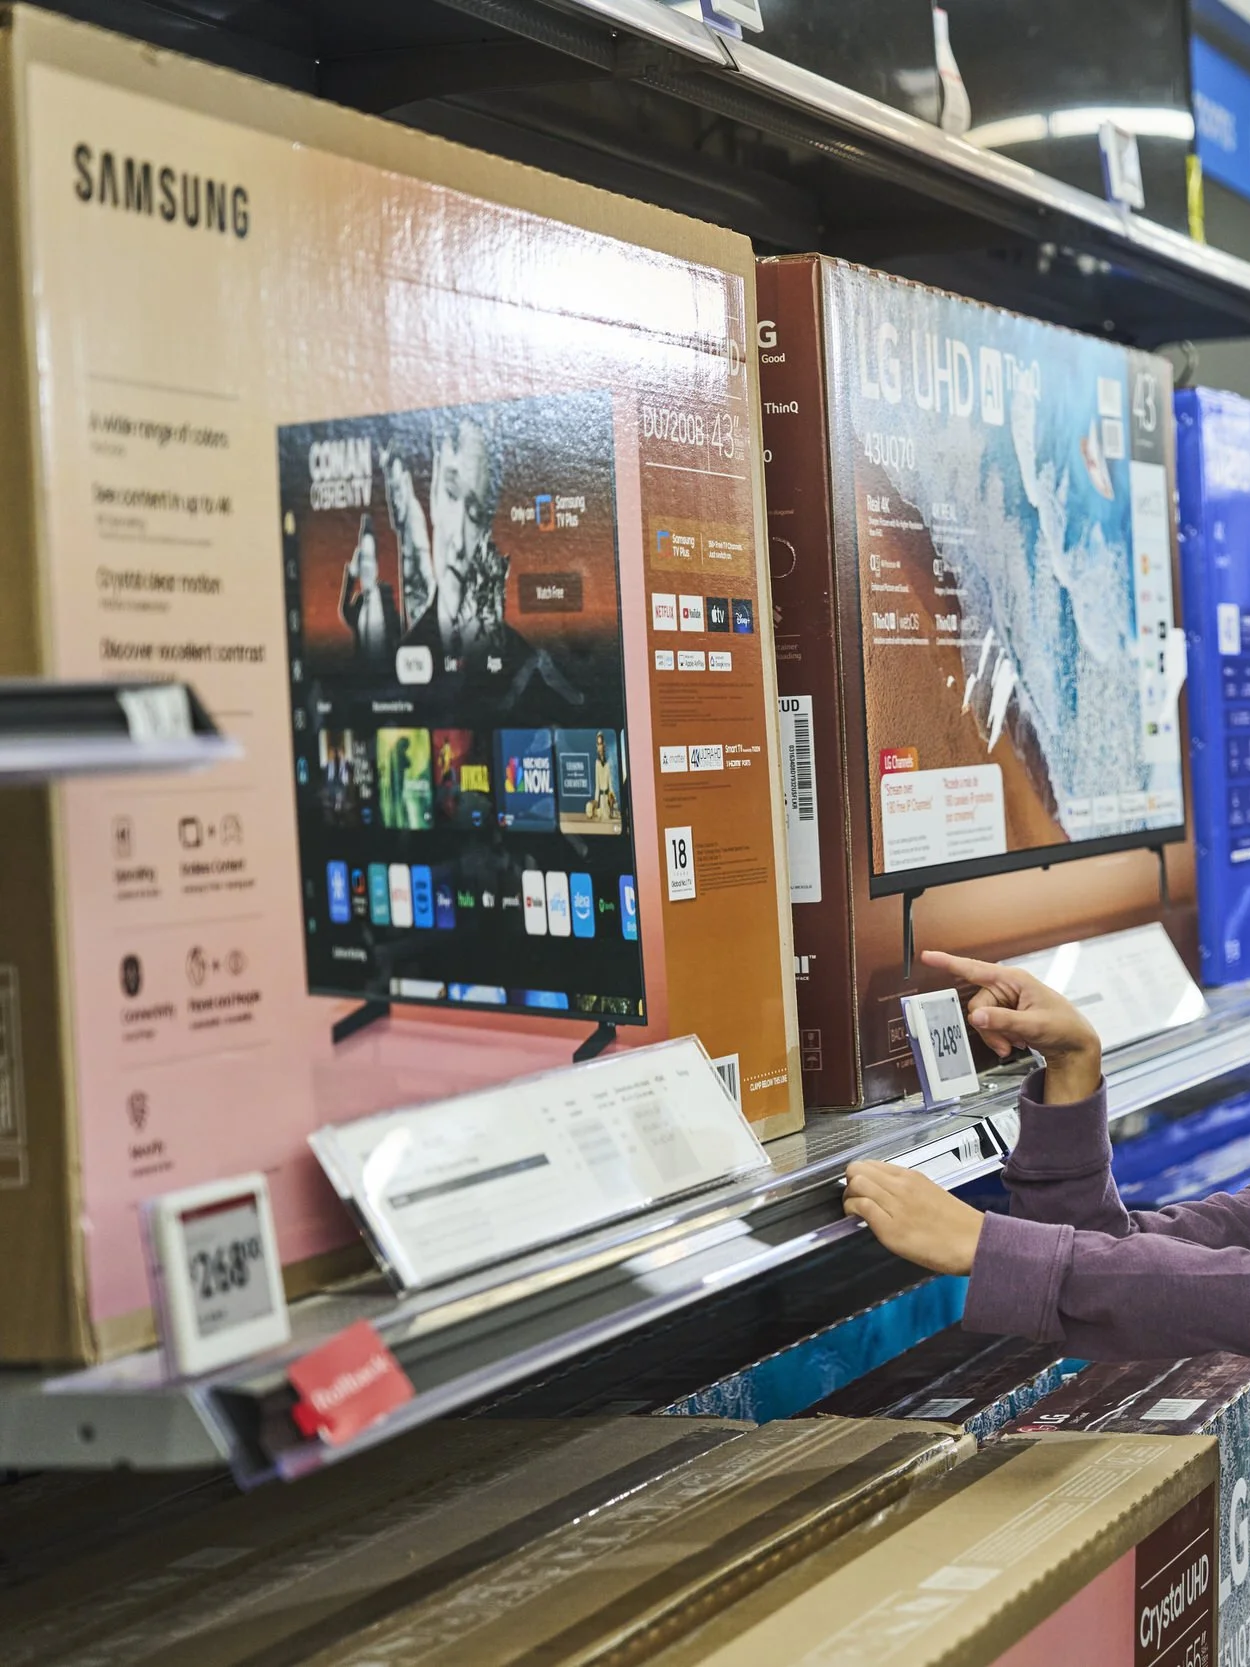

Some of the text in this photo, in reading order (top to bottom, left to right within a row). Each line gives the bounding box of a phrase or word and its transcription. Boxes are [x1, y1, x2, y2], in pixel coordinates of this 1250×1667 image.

[73, 143, 250, 238] SAMSUNG
[761, 353, 786, 364] Good
[859, 317, 901, 404] LG
[911, 329, 973, 417] UHD
[764, 401, 799, 414] ThinQ
[864, 432, 915, 473] 43UQ70
[555, 495, 585, 513] Samsung
[565, 512, 579, 528] Plus
[672, 533, 695, 549] Samsung
[655, 605, 675, 620] NETFLIX
[778, 699, 800, 713] UD
[884, 756, 892, 770] LG
[523, 769, 554, 794] NOW.
[672, 838, 688, 870] 18
[310, 1354, 390, 1412] Rollback
[1032, 1413, 1071, 1425] LG
[1140, 1553, 1209, 1650] Crystal UHD
